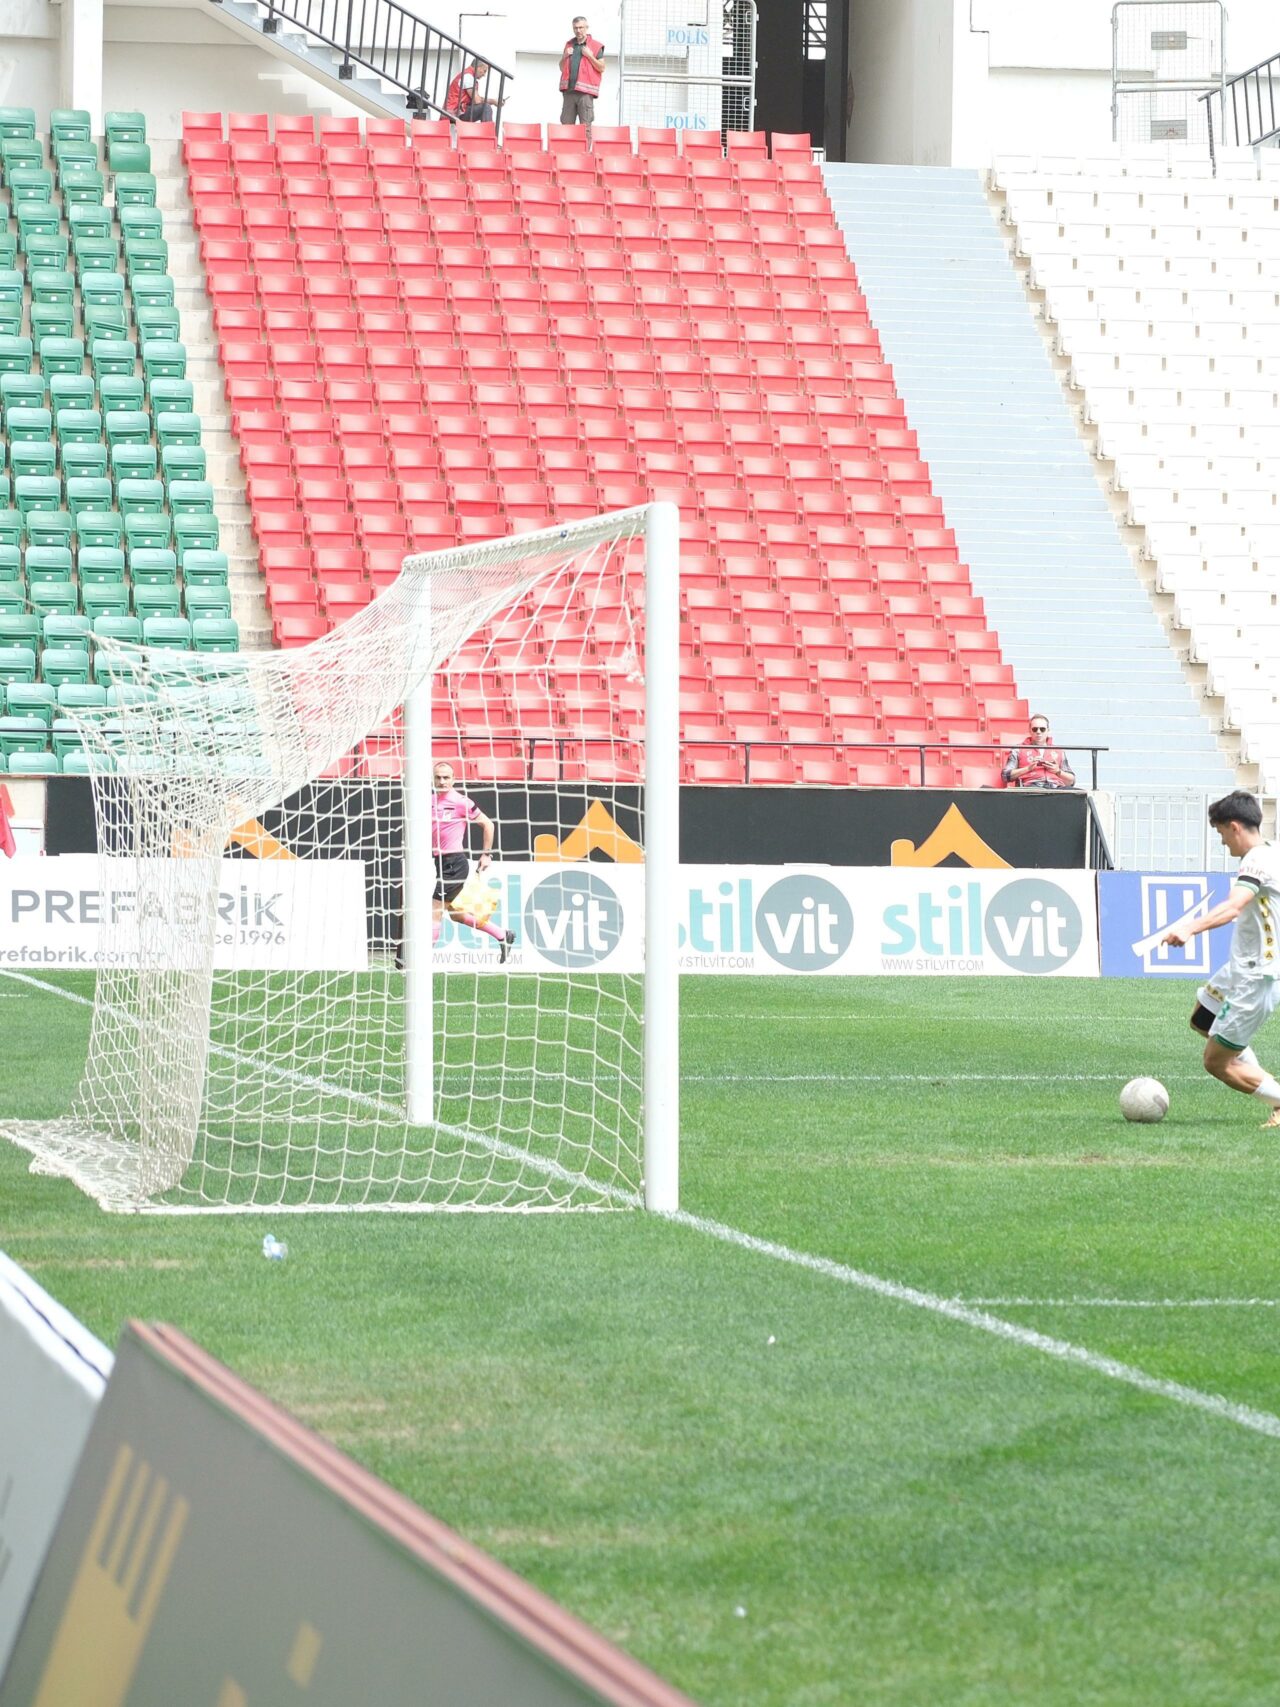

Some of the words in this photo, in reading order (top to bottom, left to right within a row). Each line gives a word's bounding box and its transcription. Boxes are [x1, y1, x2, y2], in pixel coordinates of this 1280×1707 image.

[667, 28, 709, 45] POLİS
[665, 113, 707, 130] POLİS
[533, 893, 609, 952] vit
[679, 878, 754, 953] til
[764, 896, 839, 955] vit
[880, 881, 984, 956] stil
[993, 900, 1068, 957] vit
